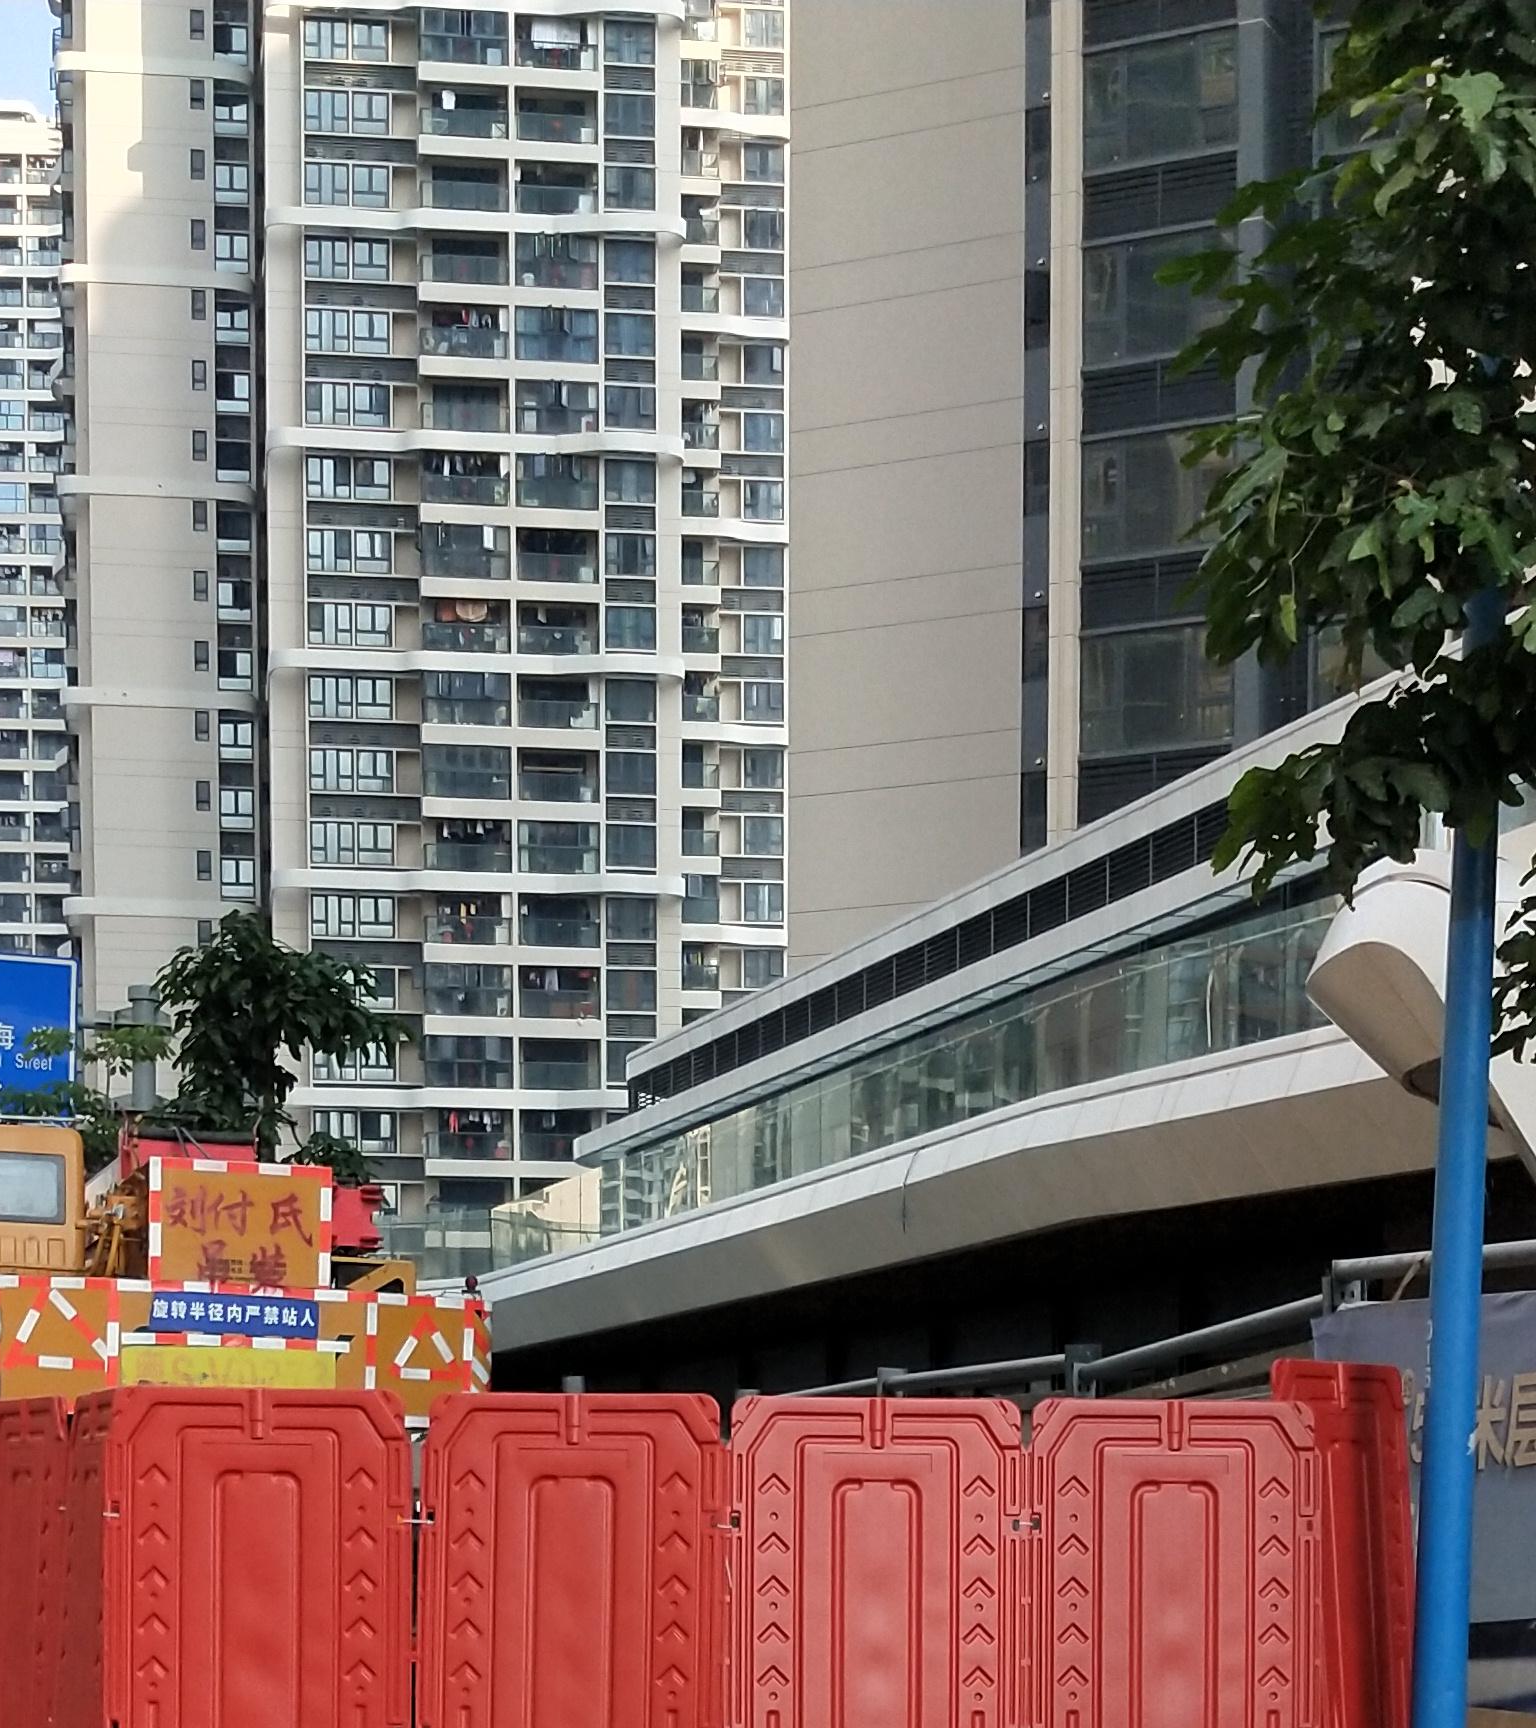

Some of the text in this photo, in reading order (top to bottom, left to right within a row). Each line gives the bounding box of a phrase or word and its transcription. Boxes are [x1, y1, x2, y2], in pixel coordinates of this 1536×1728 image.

[16, 1053, 53, 1071] Street
[152, 1299, 315, 1328] 旋转半径内严禁站人
